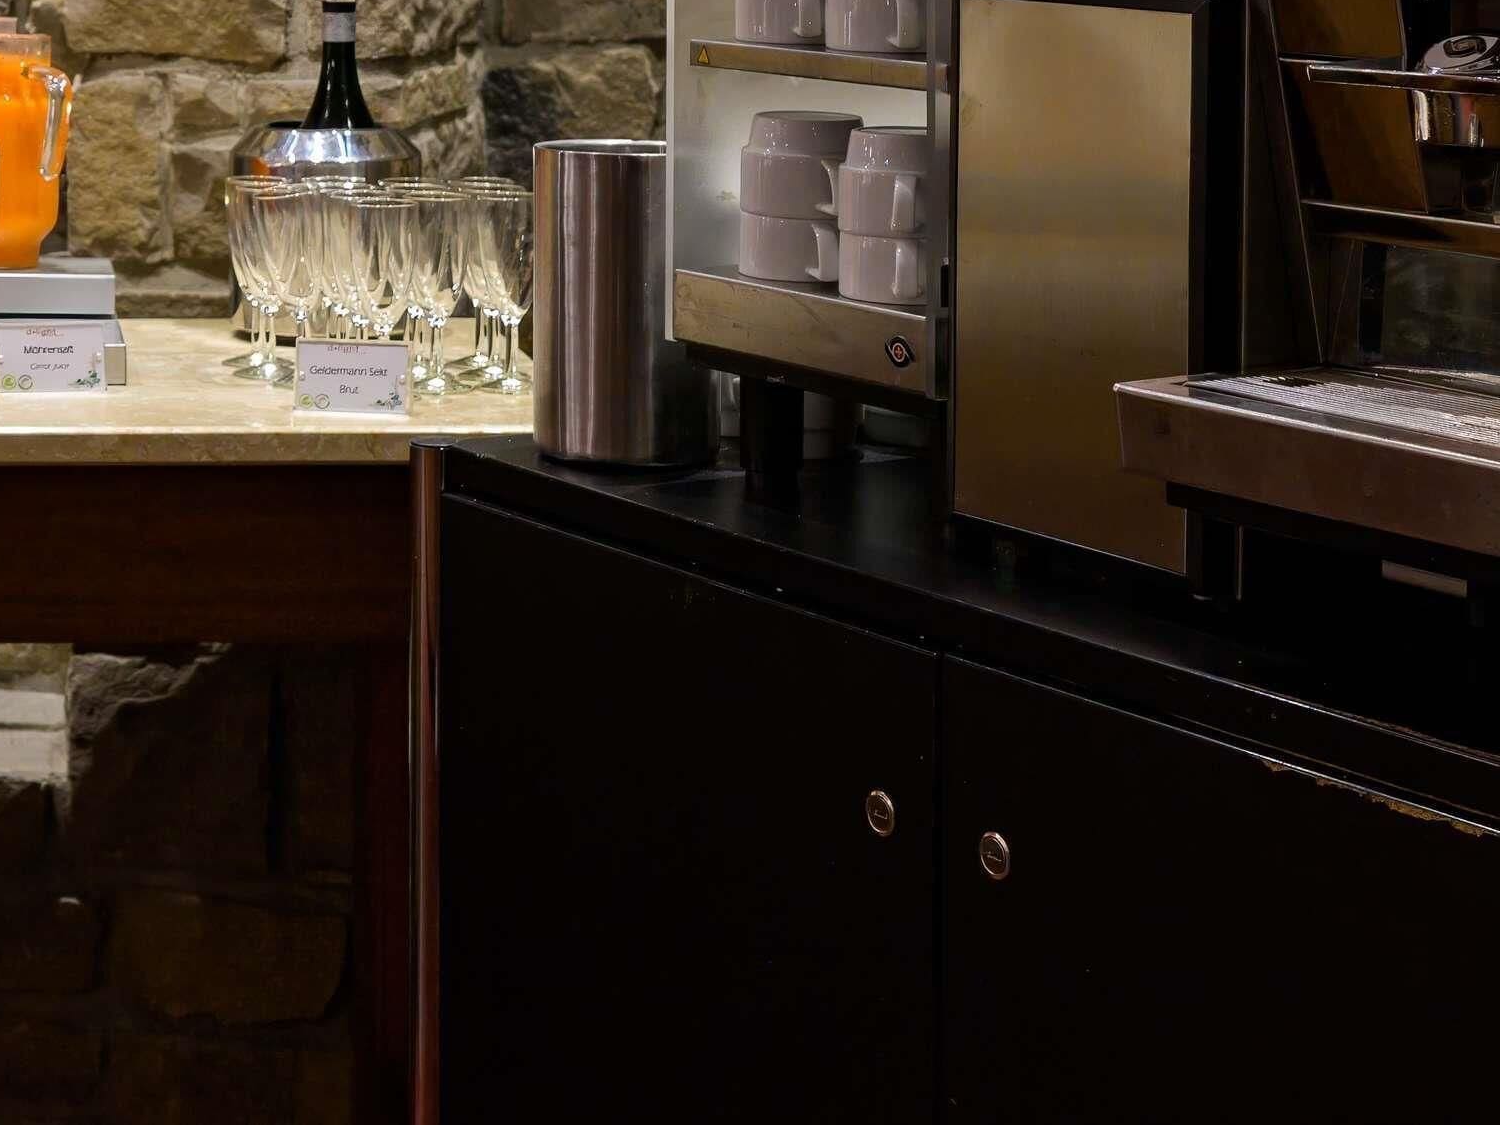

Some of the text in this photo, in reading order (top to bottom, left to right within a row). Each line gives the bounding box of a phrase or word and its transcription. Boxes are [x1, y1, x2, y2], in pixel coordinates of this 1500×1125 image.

[309, 365, 388, 377] Geldermann Sekt
[339, 384, 359, 394] Brut
